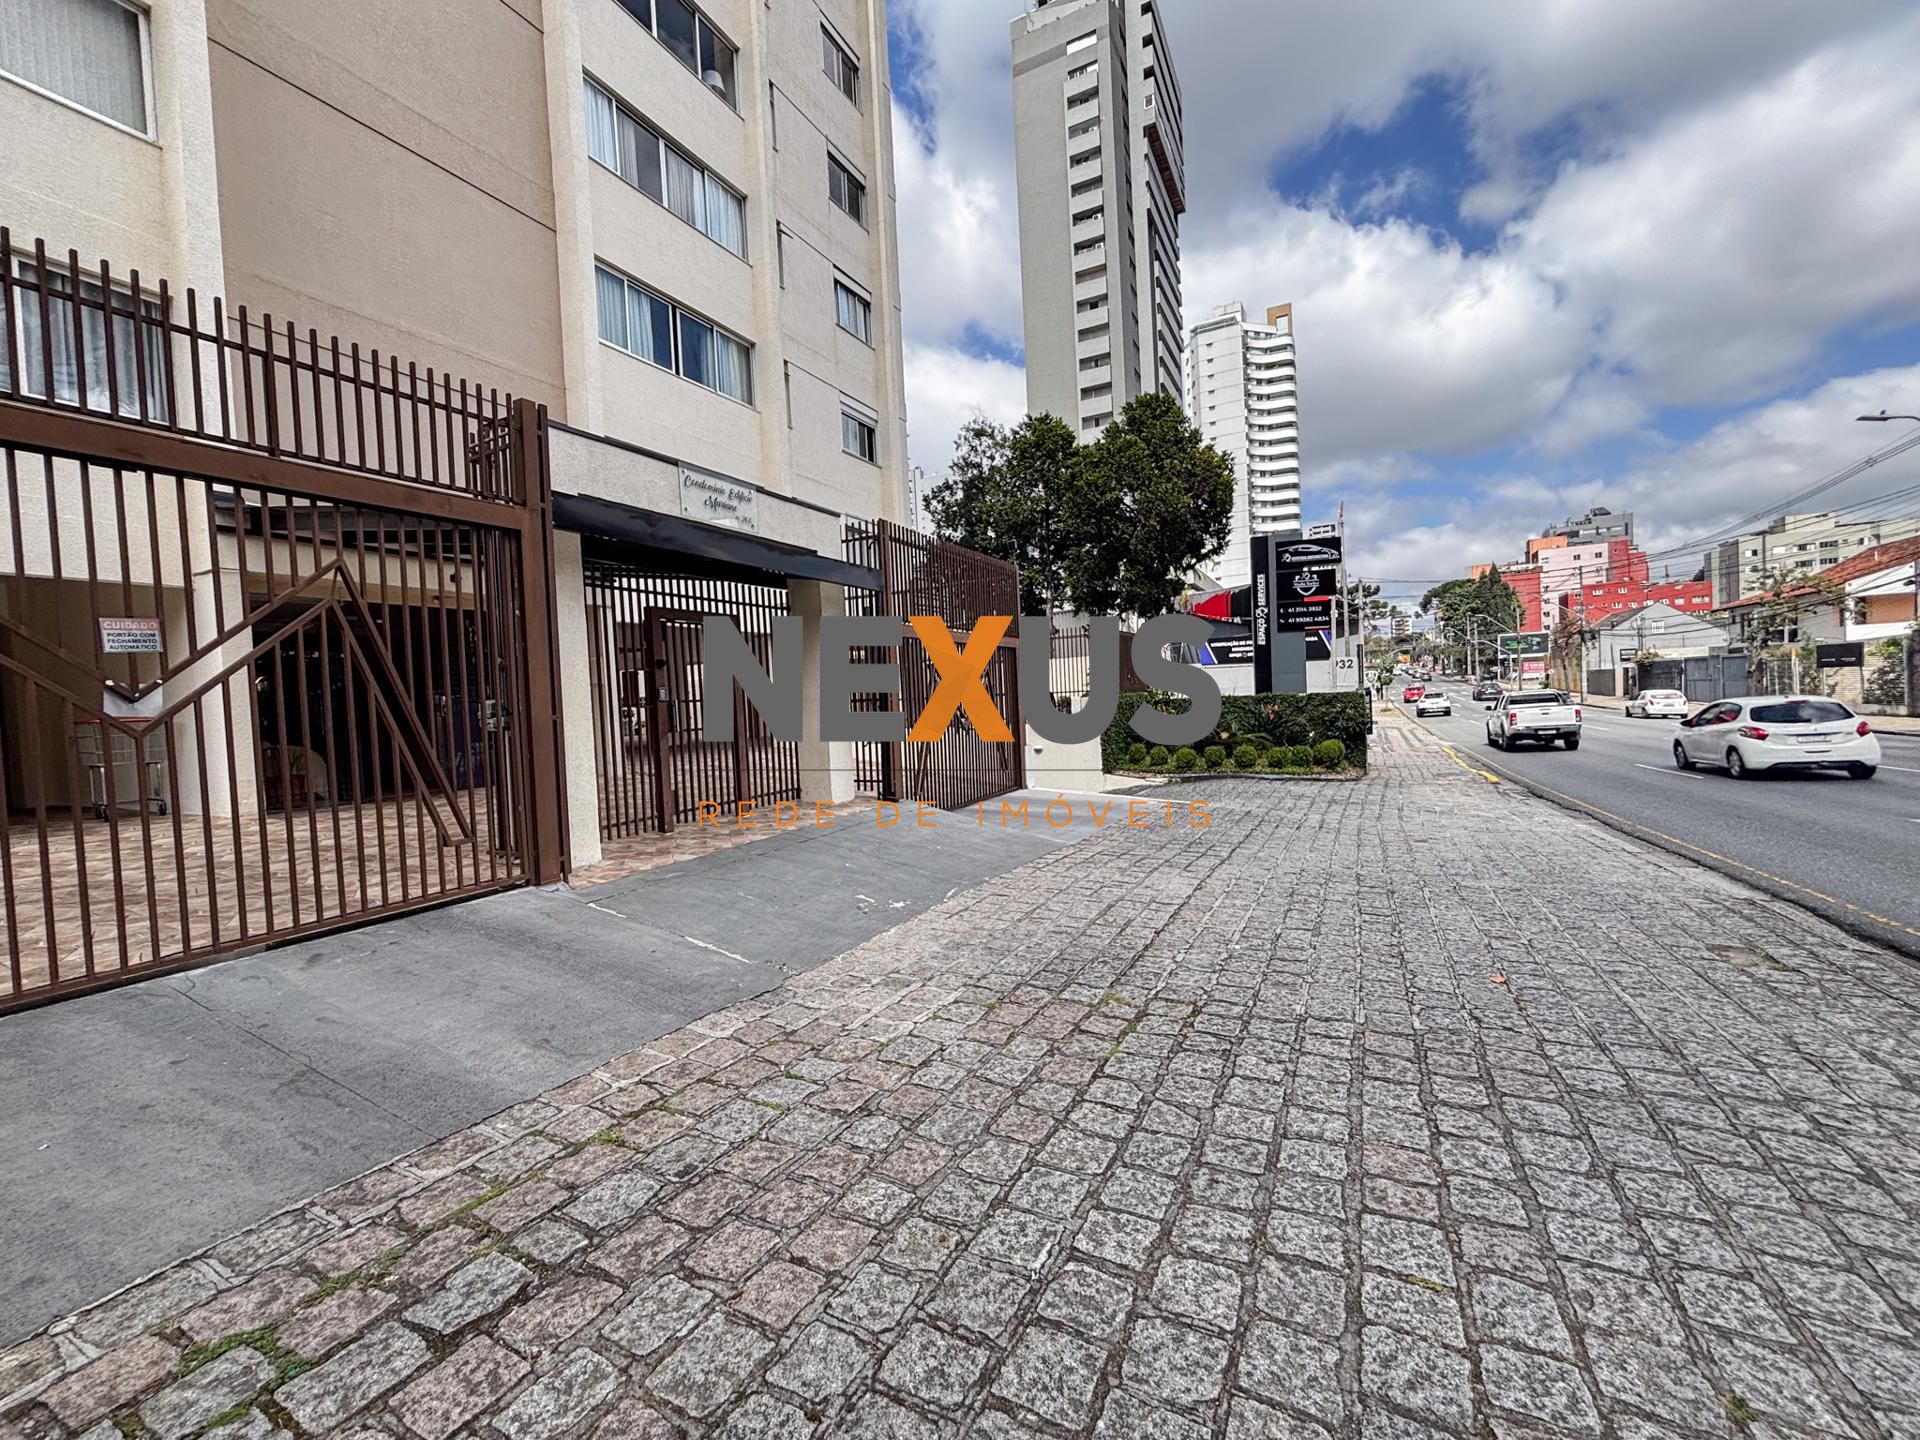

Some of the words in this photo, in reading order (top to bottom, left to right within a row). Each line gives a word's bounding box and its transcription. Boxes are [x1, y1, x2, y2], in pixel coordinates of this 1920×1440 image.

[1257, 574, 1266, 606] SERVICES
[103, 621, 157, 630] CUIDADO
[1257, 619, 1267, 645] ESPAÇO
